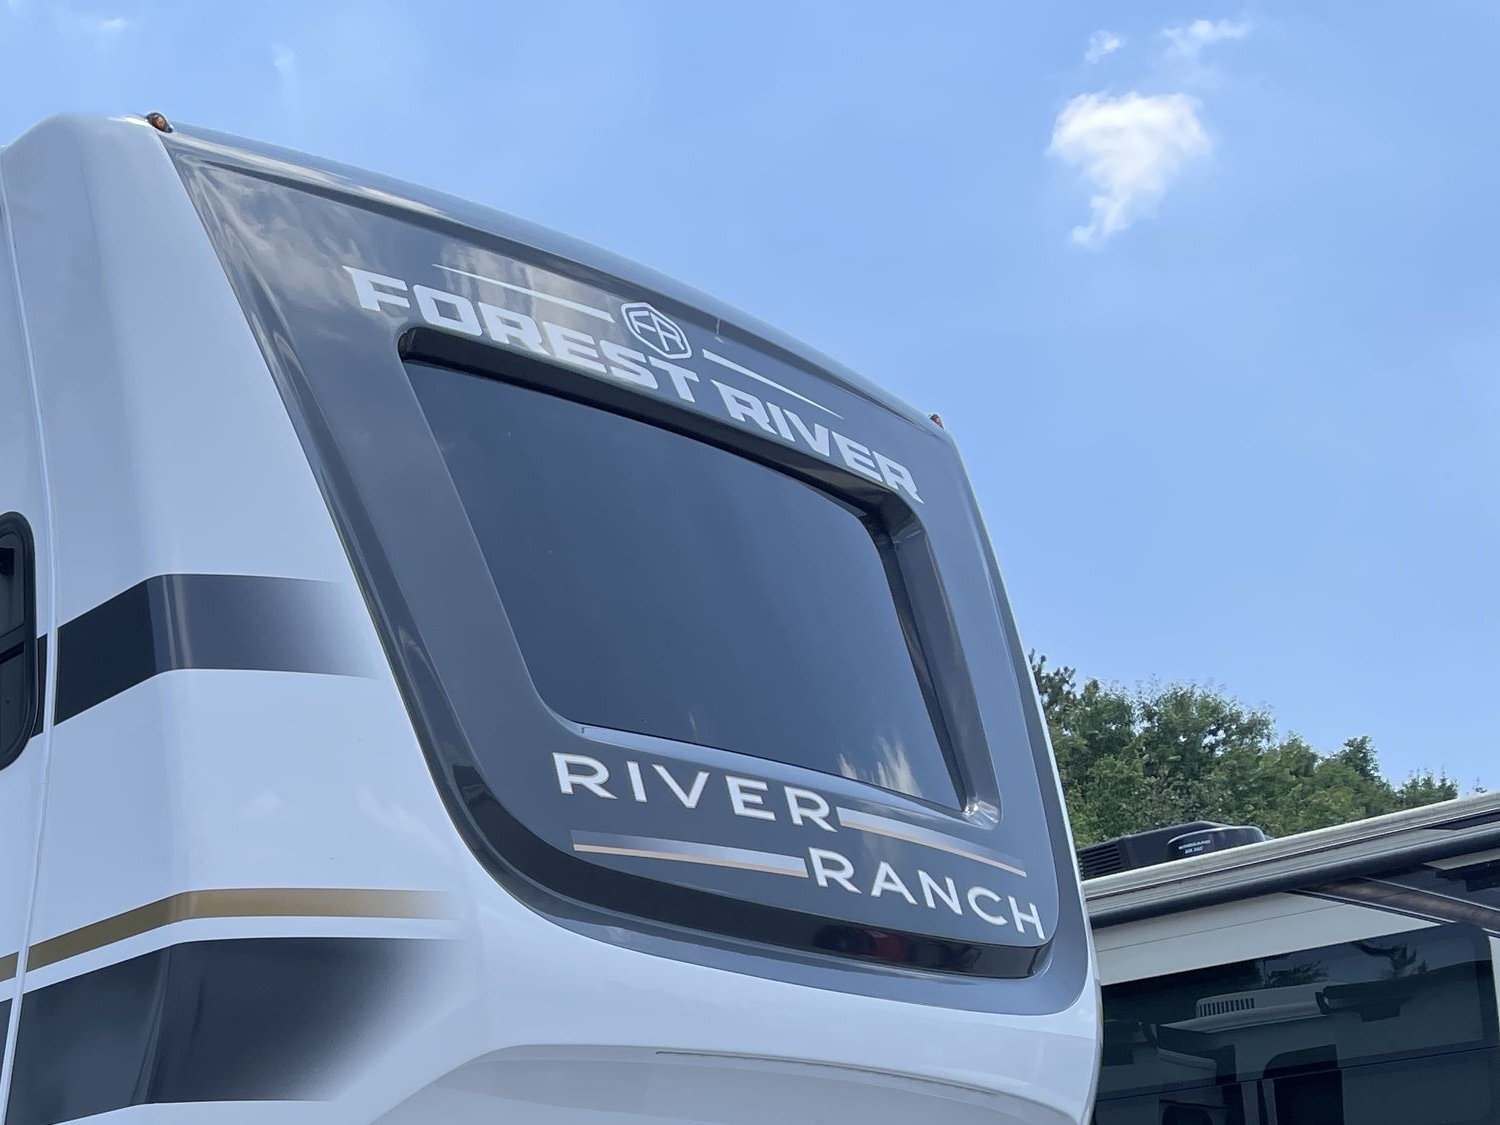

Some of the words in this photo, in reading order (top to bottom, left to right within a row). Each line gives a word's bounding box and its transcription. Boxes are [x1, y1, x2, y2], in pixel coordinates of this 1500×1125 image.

[343, 265, 700, 403] FOREST
[710, 379, 924, 504] RIVER
[552, 752, 838, 832] RIVER
[808, 846, 1046, 940] RANCH
